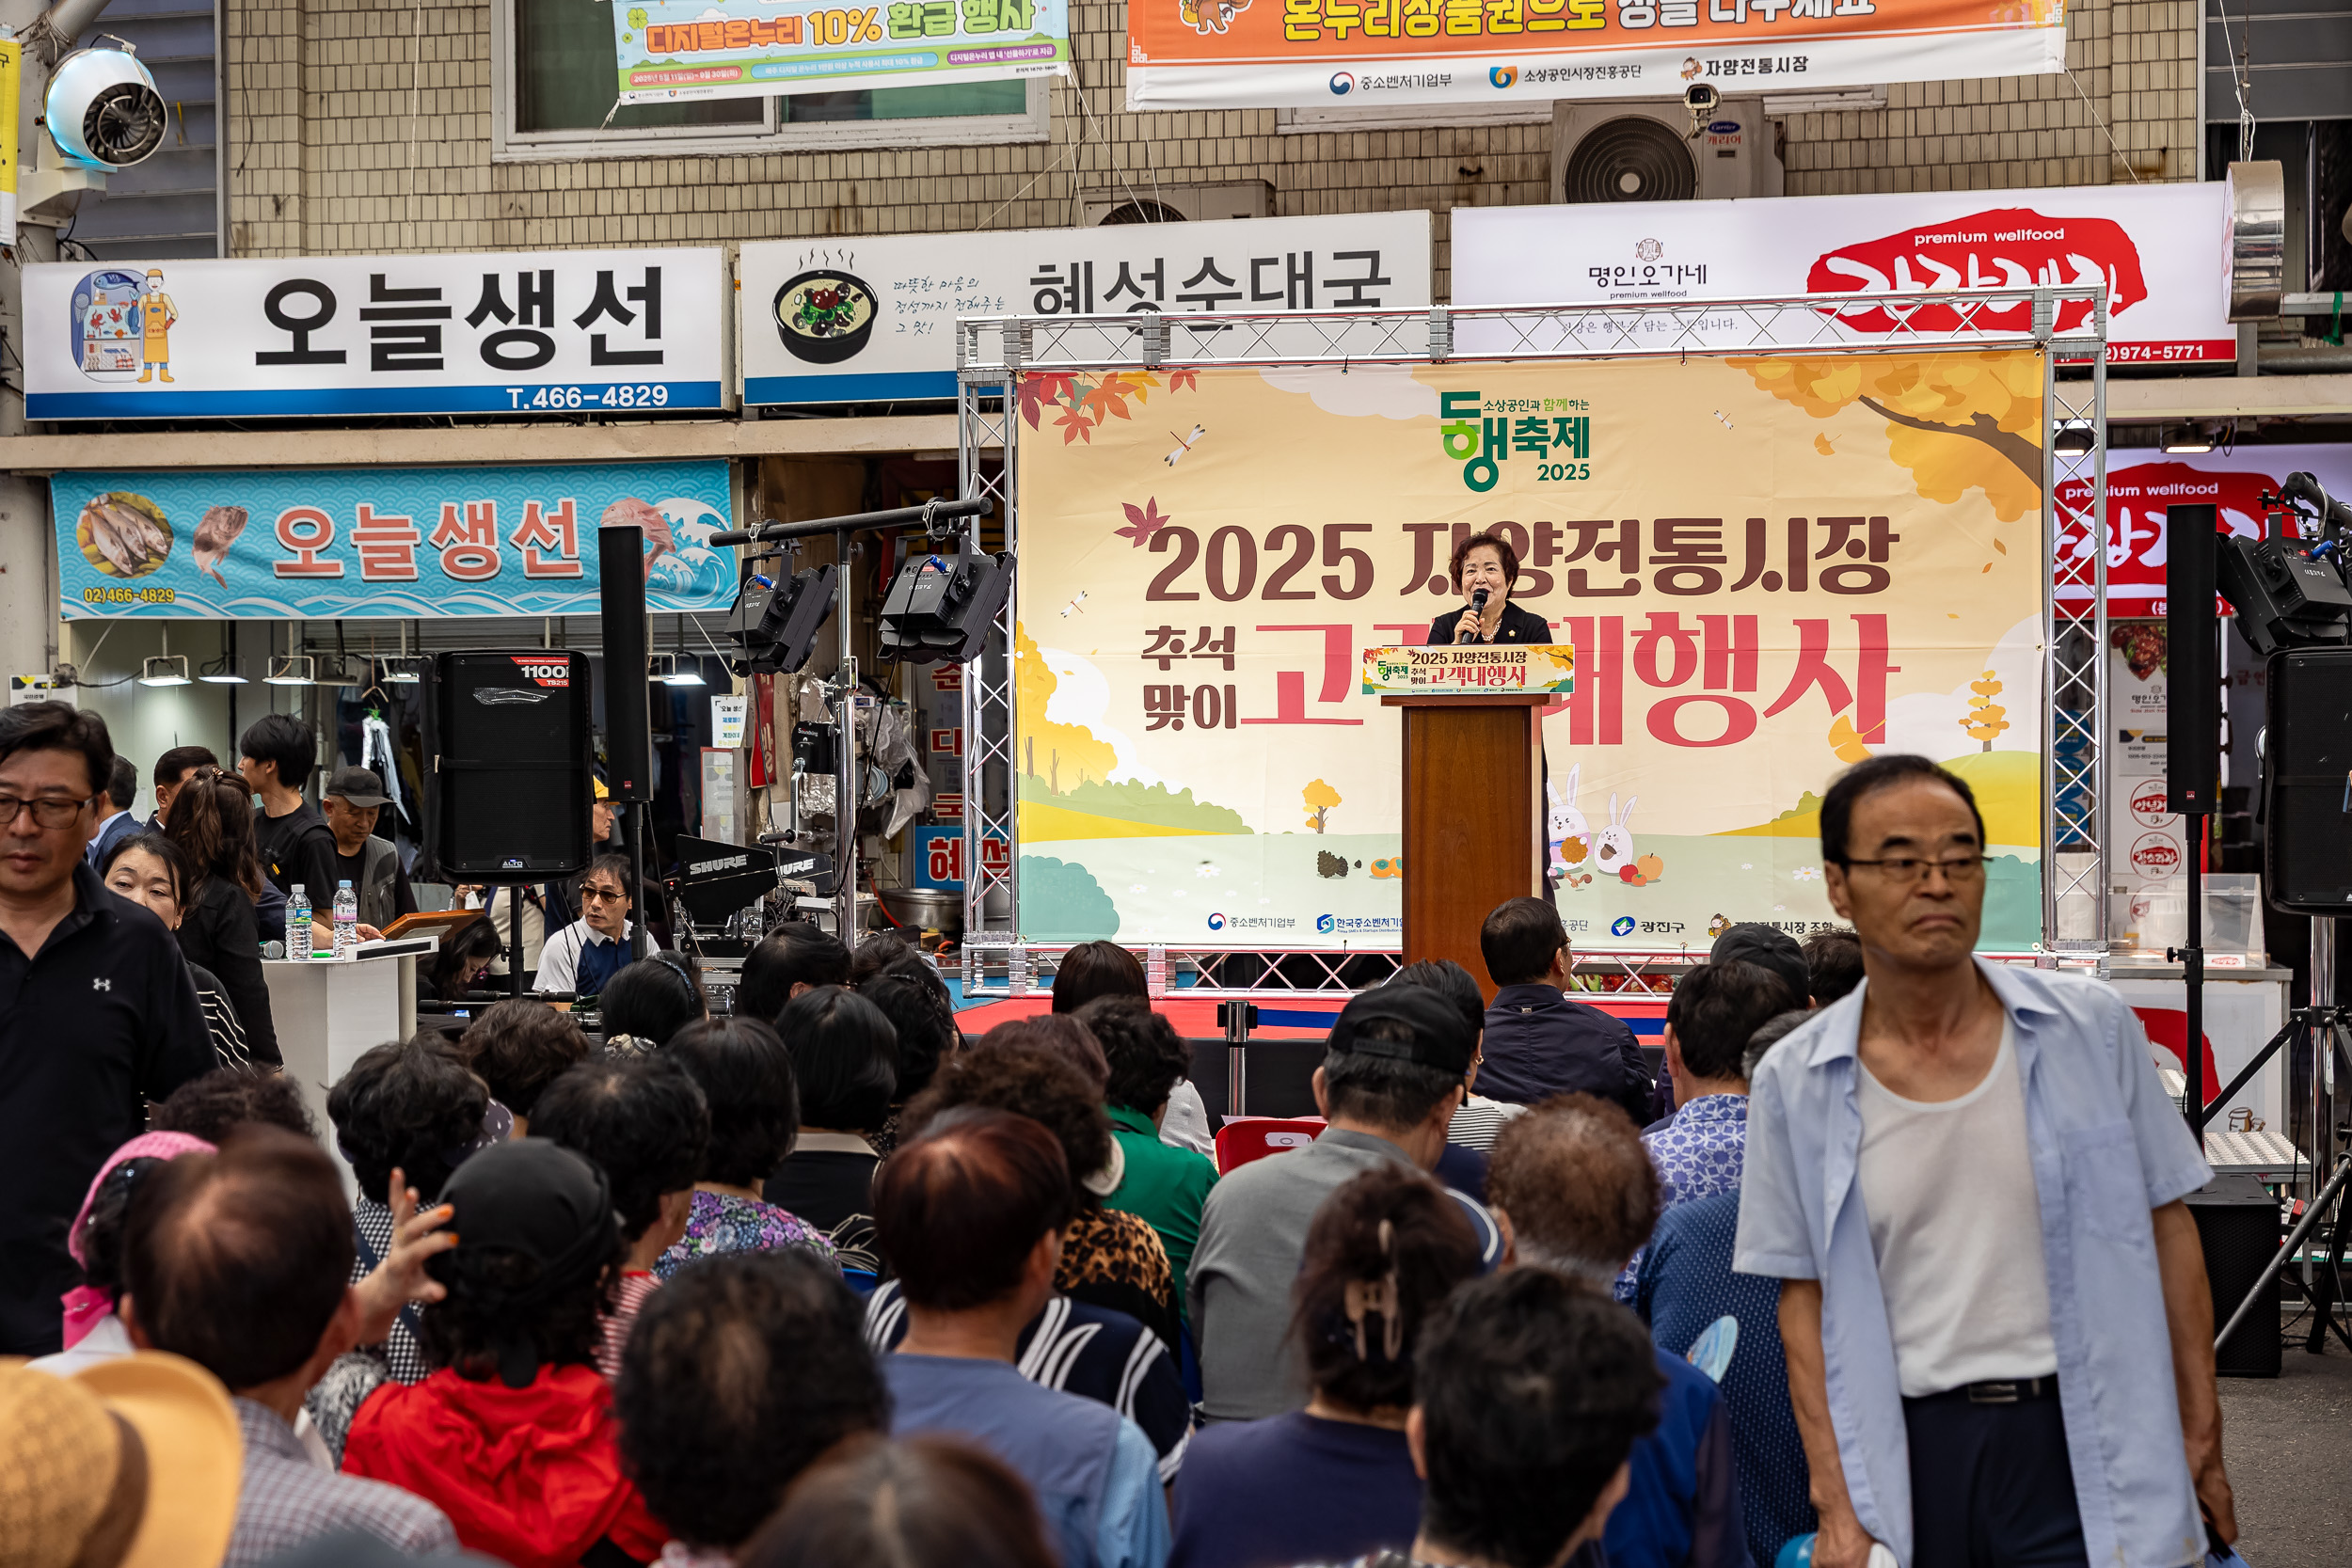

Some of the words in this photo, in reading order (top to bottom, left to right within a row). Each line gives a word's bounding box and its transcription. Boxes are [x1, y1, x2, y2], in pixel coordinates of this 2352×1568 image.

[646, 15, 803, 53] 디지털온누리
[807, 8, 882, 45] 10%
[887, 3, 957, 39] 환급
[962, 0, 1036, 34] 행사
[1283, 0, 1607, 40] 온누리상품권으로
[1524, 65, 1642, 83] 소상공인시장진흥공단
[1706, 55, 1809, 76] 자양전통시장
[1360, 72, 1453, 90] 중소벤처기업부
[1708, 135, 1741, 145] 캐리어
[1915, 230, 1988, 246] premium
[1994, 228, 2065, 242] wellfood
[894, 276, 934, 294] 따뜻한
[939, 276, 980, 293] 마음의
[1589, 264, 1707, 288] 명인오가네
[895, 300, 947, 314] 정성까지
[954, 295, 1006, 314] 전해주는
[1610, 291, 1648, 300] premium
[256, 266, 664, 372] 오늘생선
[895, 323, 907, 332] 그
[913, 321, 934, 336] 맛!
[507, 384, 669, 411] T.466-4829
[1483, 399, 1541, 413] 소상공인과
[1543, 398, 1590, 412] 함께하는
[1537, 464, 1591, 481] 2025
[2146, 483, 2218, 496] wellfood
[274, 499, 583, 580] 오늘생선
[1145, 523, 1375, 602] 2025
[1400, 516, 1900, 598] 자양전통시장
[84, 586, 176, 605] 02)466-4829
[1141, 625, 1236, 672] 추석
[1411, 652, 1449, 665] 2025
[1452, 651, 1528, 664] 자양전통시장
[521, 665, 566, 678] 1100
[1241, 612, 1901, 748] 고대행사
[1410, 667, 1426, 676] 추석
[1426, 665, 1528, 687] 고객대행사
[1143, 684, 1238, 731] 맞이
[690, 854, 748, 876] SHURE
[775, 858, 814, 876] URE
[1230, 917, 1296, 928] 중소벤처기업부
[1640, 920, 1686, 934] 광진구
